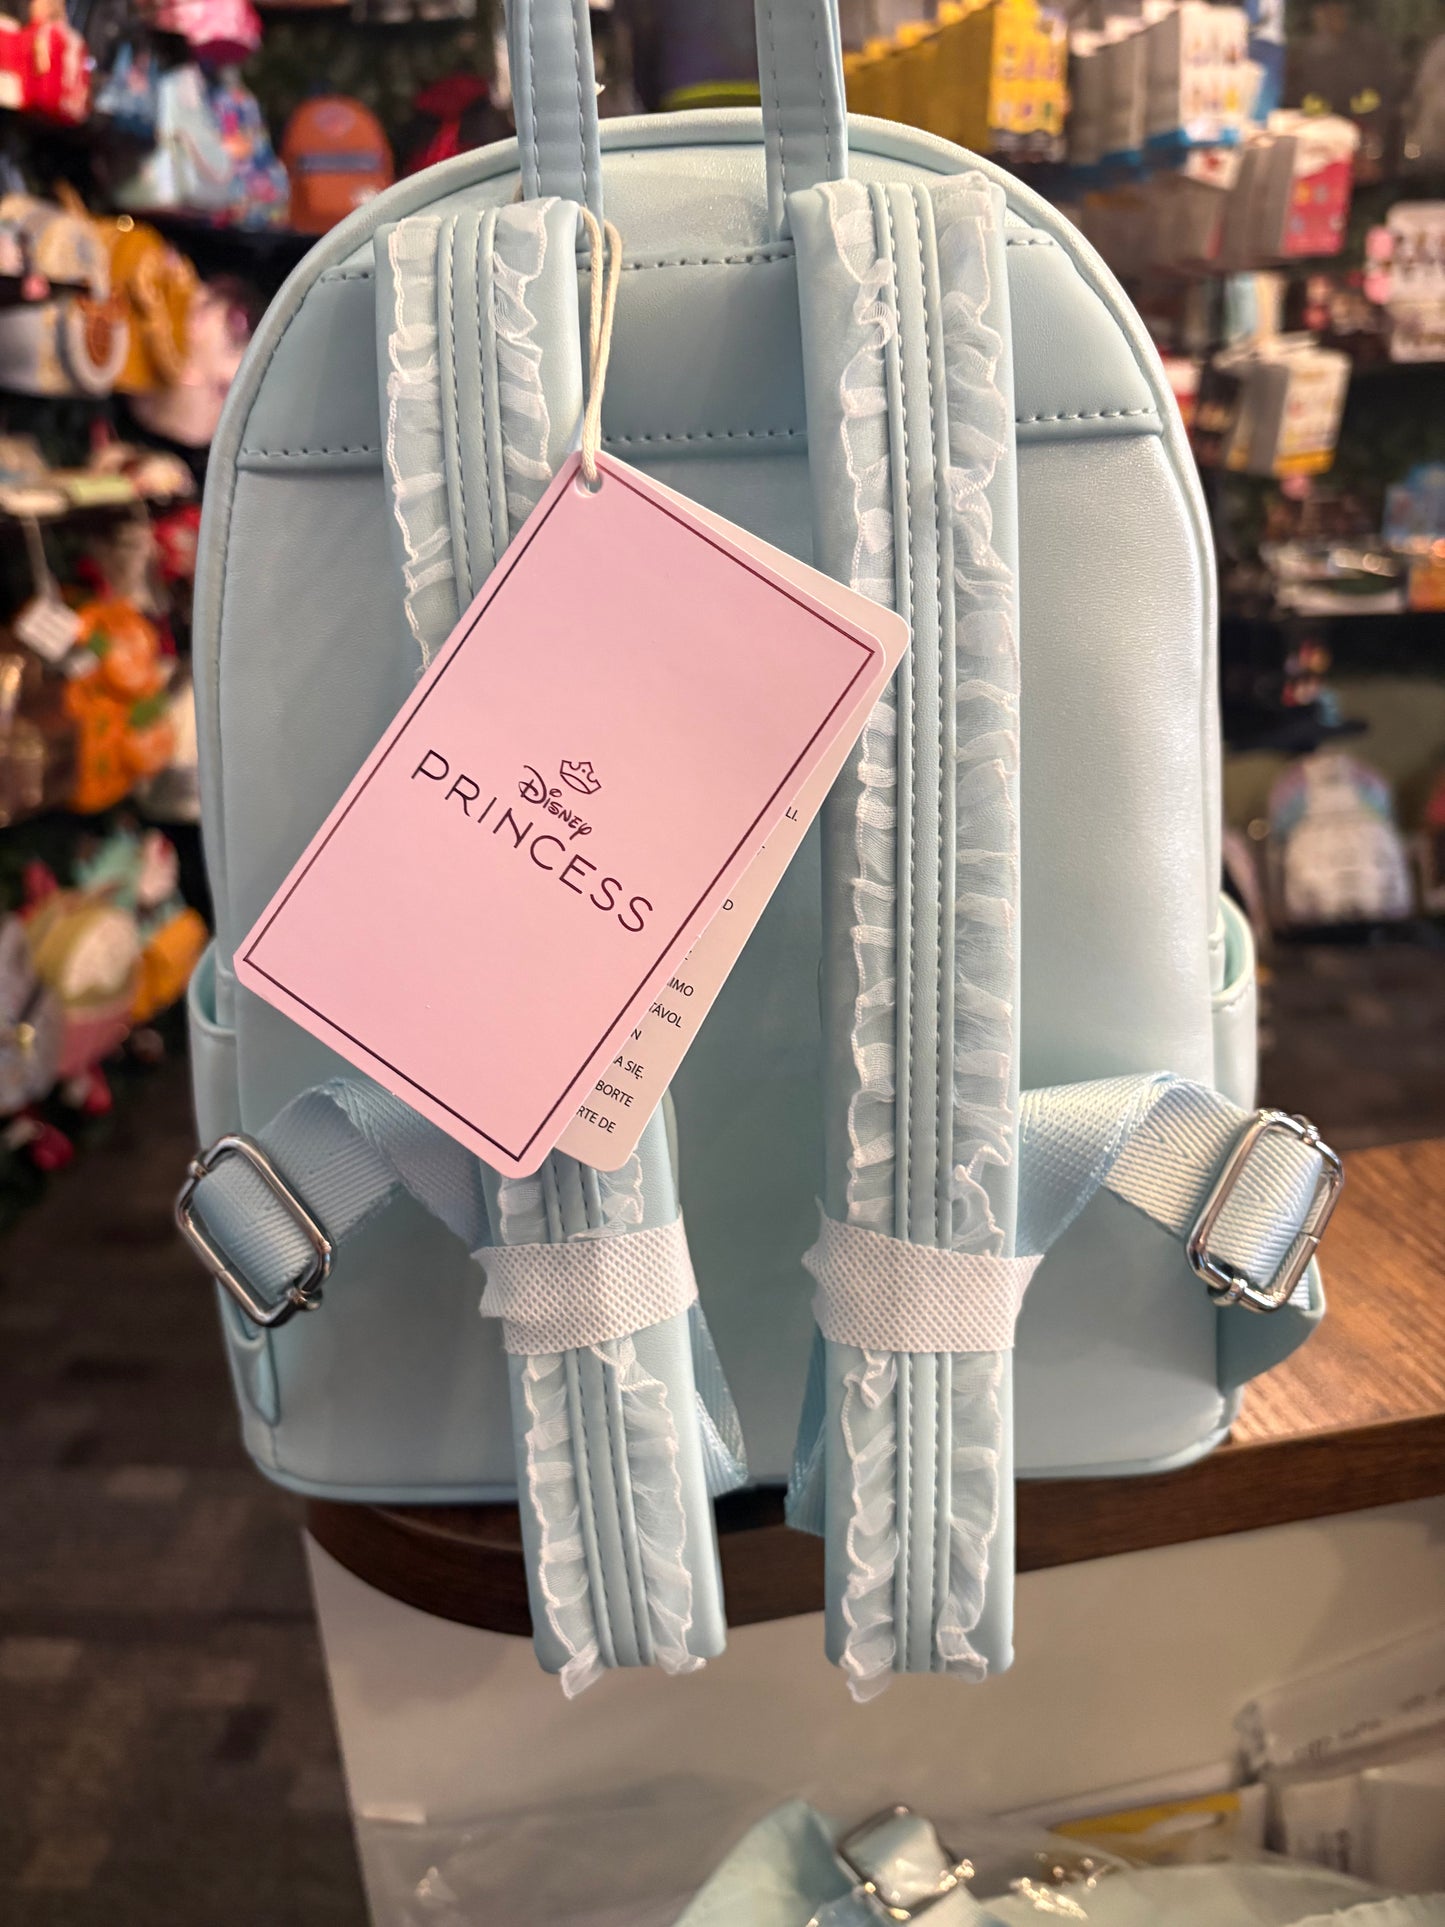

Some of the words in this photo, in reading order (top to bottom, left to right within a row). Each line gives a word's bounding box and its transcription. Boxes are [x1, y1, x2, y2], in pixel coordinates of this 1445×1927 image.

[411, 749, 653, 932] PRINCESS
[667, 977, 694, 997] IMO
[595, 1079, 634, 1107] BORTE
[598, 1117, 617, 1133] DE
